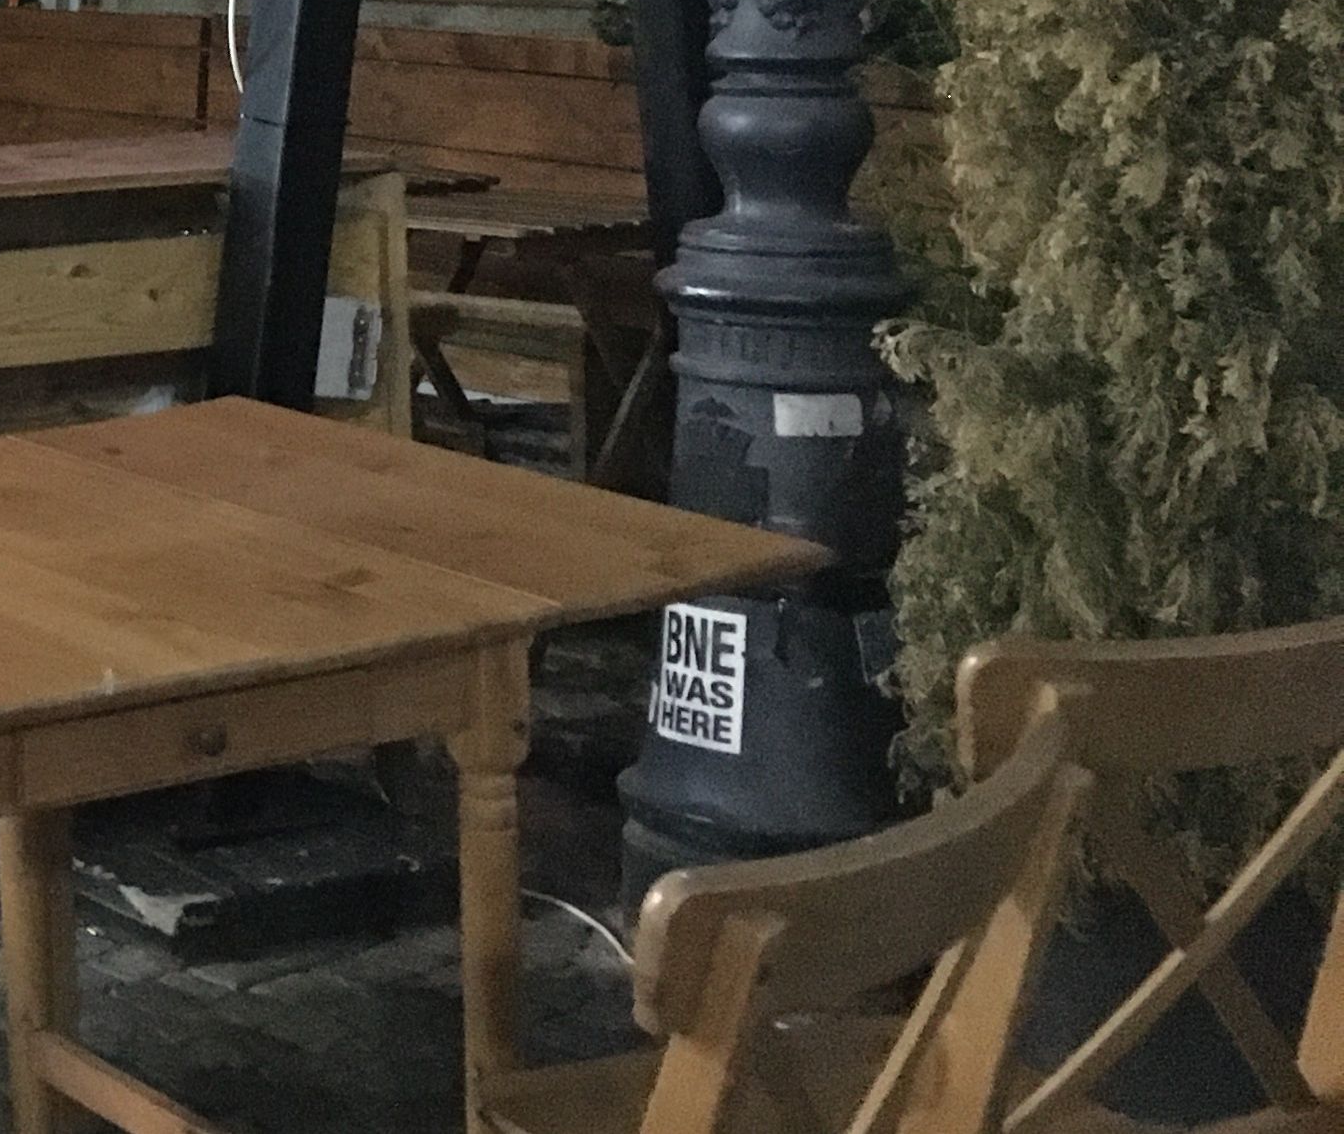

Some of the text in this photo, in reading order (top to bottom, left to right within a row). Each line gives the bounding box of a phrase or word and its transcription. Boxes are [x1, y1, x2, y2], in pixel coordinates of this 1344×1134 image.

[666, 610, 737, 678] BNE
[665, 669, 734, 710] WAS
[661, 700, 733, 745] HERE
